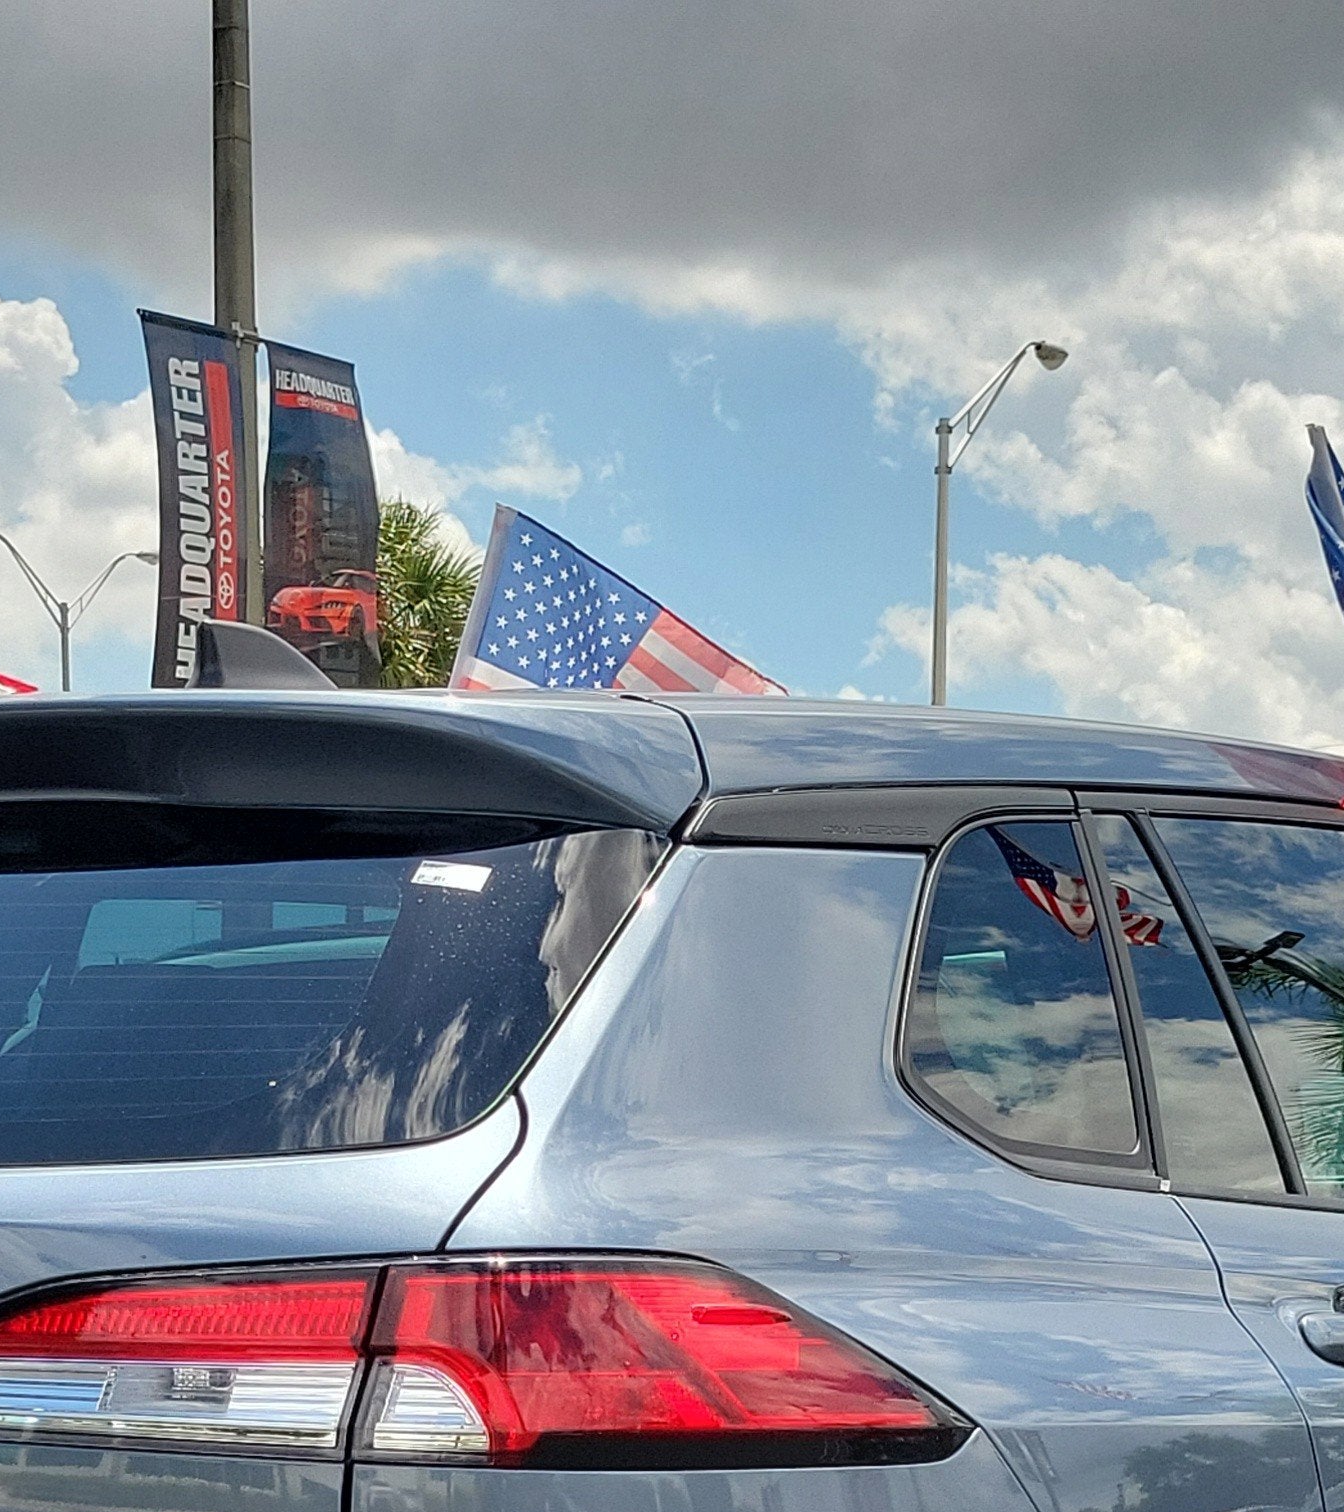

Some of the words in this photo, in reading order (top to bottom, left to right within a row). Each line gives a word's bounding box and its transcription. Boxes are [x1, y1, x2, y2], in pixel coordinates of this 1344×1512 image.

[276, 369, 356, 406] HEADQUARTER
[168, 357, 214, 679] HEADQUARTER
[215, 449, 233, 568] TOYOTA
